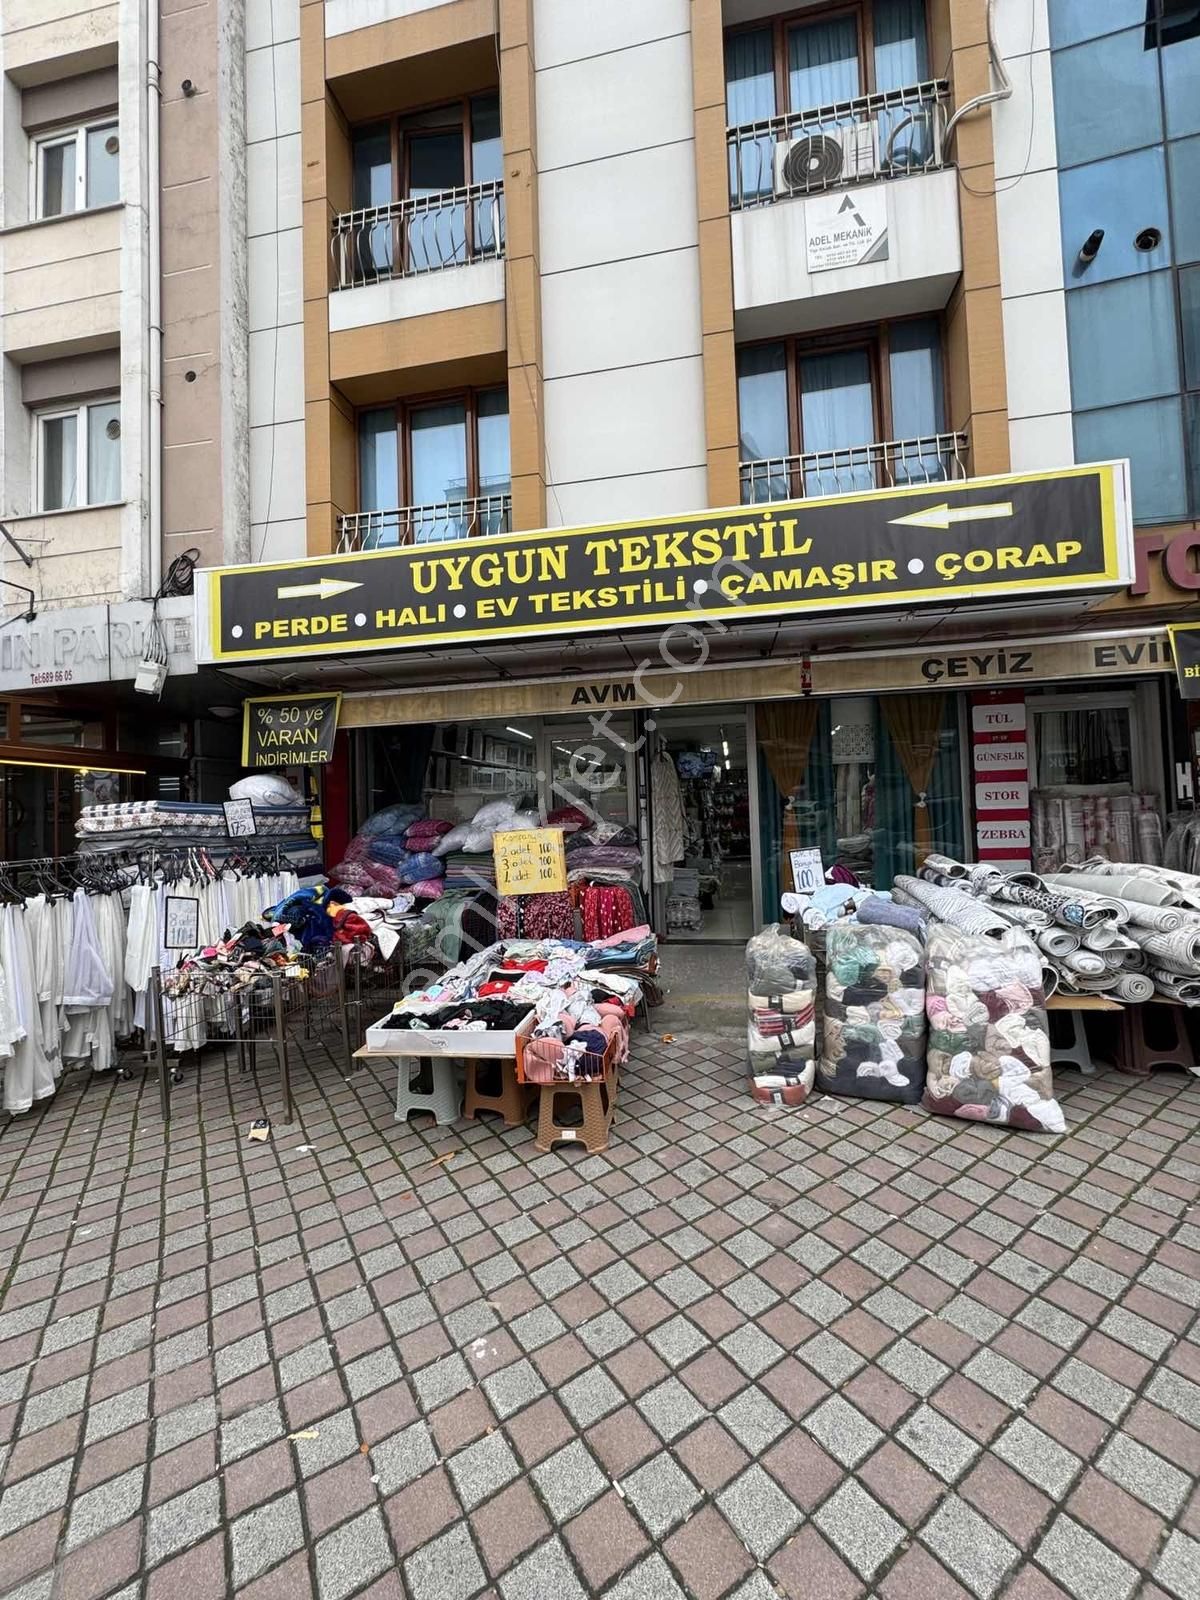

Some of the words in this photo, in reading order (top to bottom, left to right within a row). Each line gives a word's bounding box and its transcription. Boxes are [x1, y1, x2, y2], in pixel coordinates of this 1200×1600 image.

[809, 235, 831, 247] ADEL
[410, 544, 570, 594] UYGUN
[585, 511, 812, 576] TEKSTİL
[254, 613, 348, 639] PERDE
[376, 604, 446, 628] HALI
[477, 597, 519, 619] EV
[529, 576, 686, 613] TEKSTİLİ
[721, 559, 898, 600] ÇAMAŞIR
[935, 541, 1082, 580] ÇORAP
[921, 651, 1034, 682] ÇEYİZ
[571, 684, 636, 706] AVM
[280, 707, 300, 723] 50
[304, 708, 324, 725] ye
[985, 711, 1014, 723] TÜL
[257, 728, 318, 747] VARAN
[256, 750, 328, 767] İNDİRİMLER
[976, 751, 1025, 763] GÜNEŞLİK
[985, 790, 1020, 801] STOR
[981, 829, 1026, 840] ZEBRA
[501, 859, 509, 870] 3
